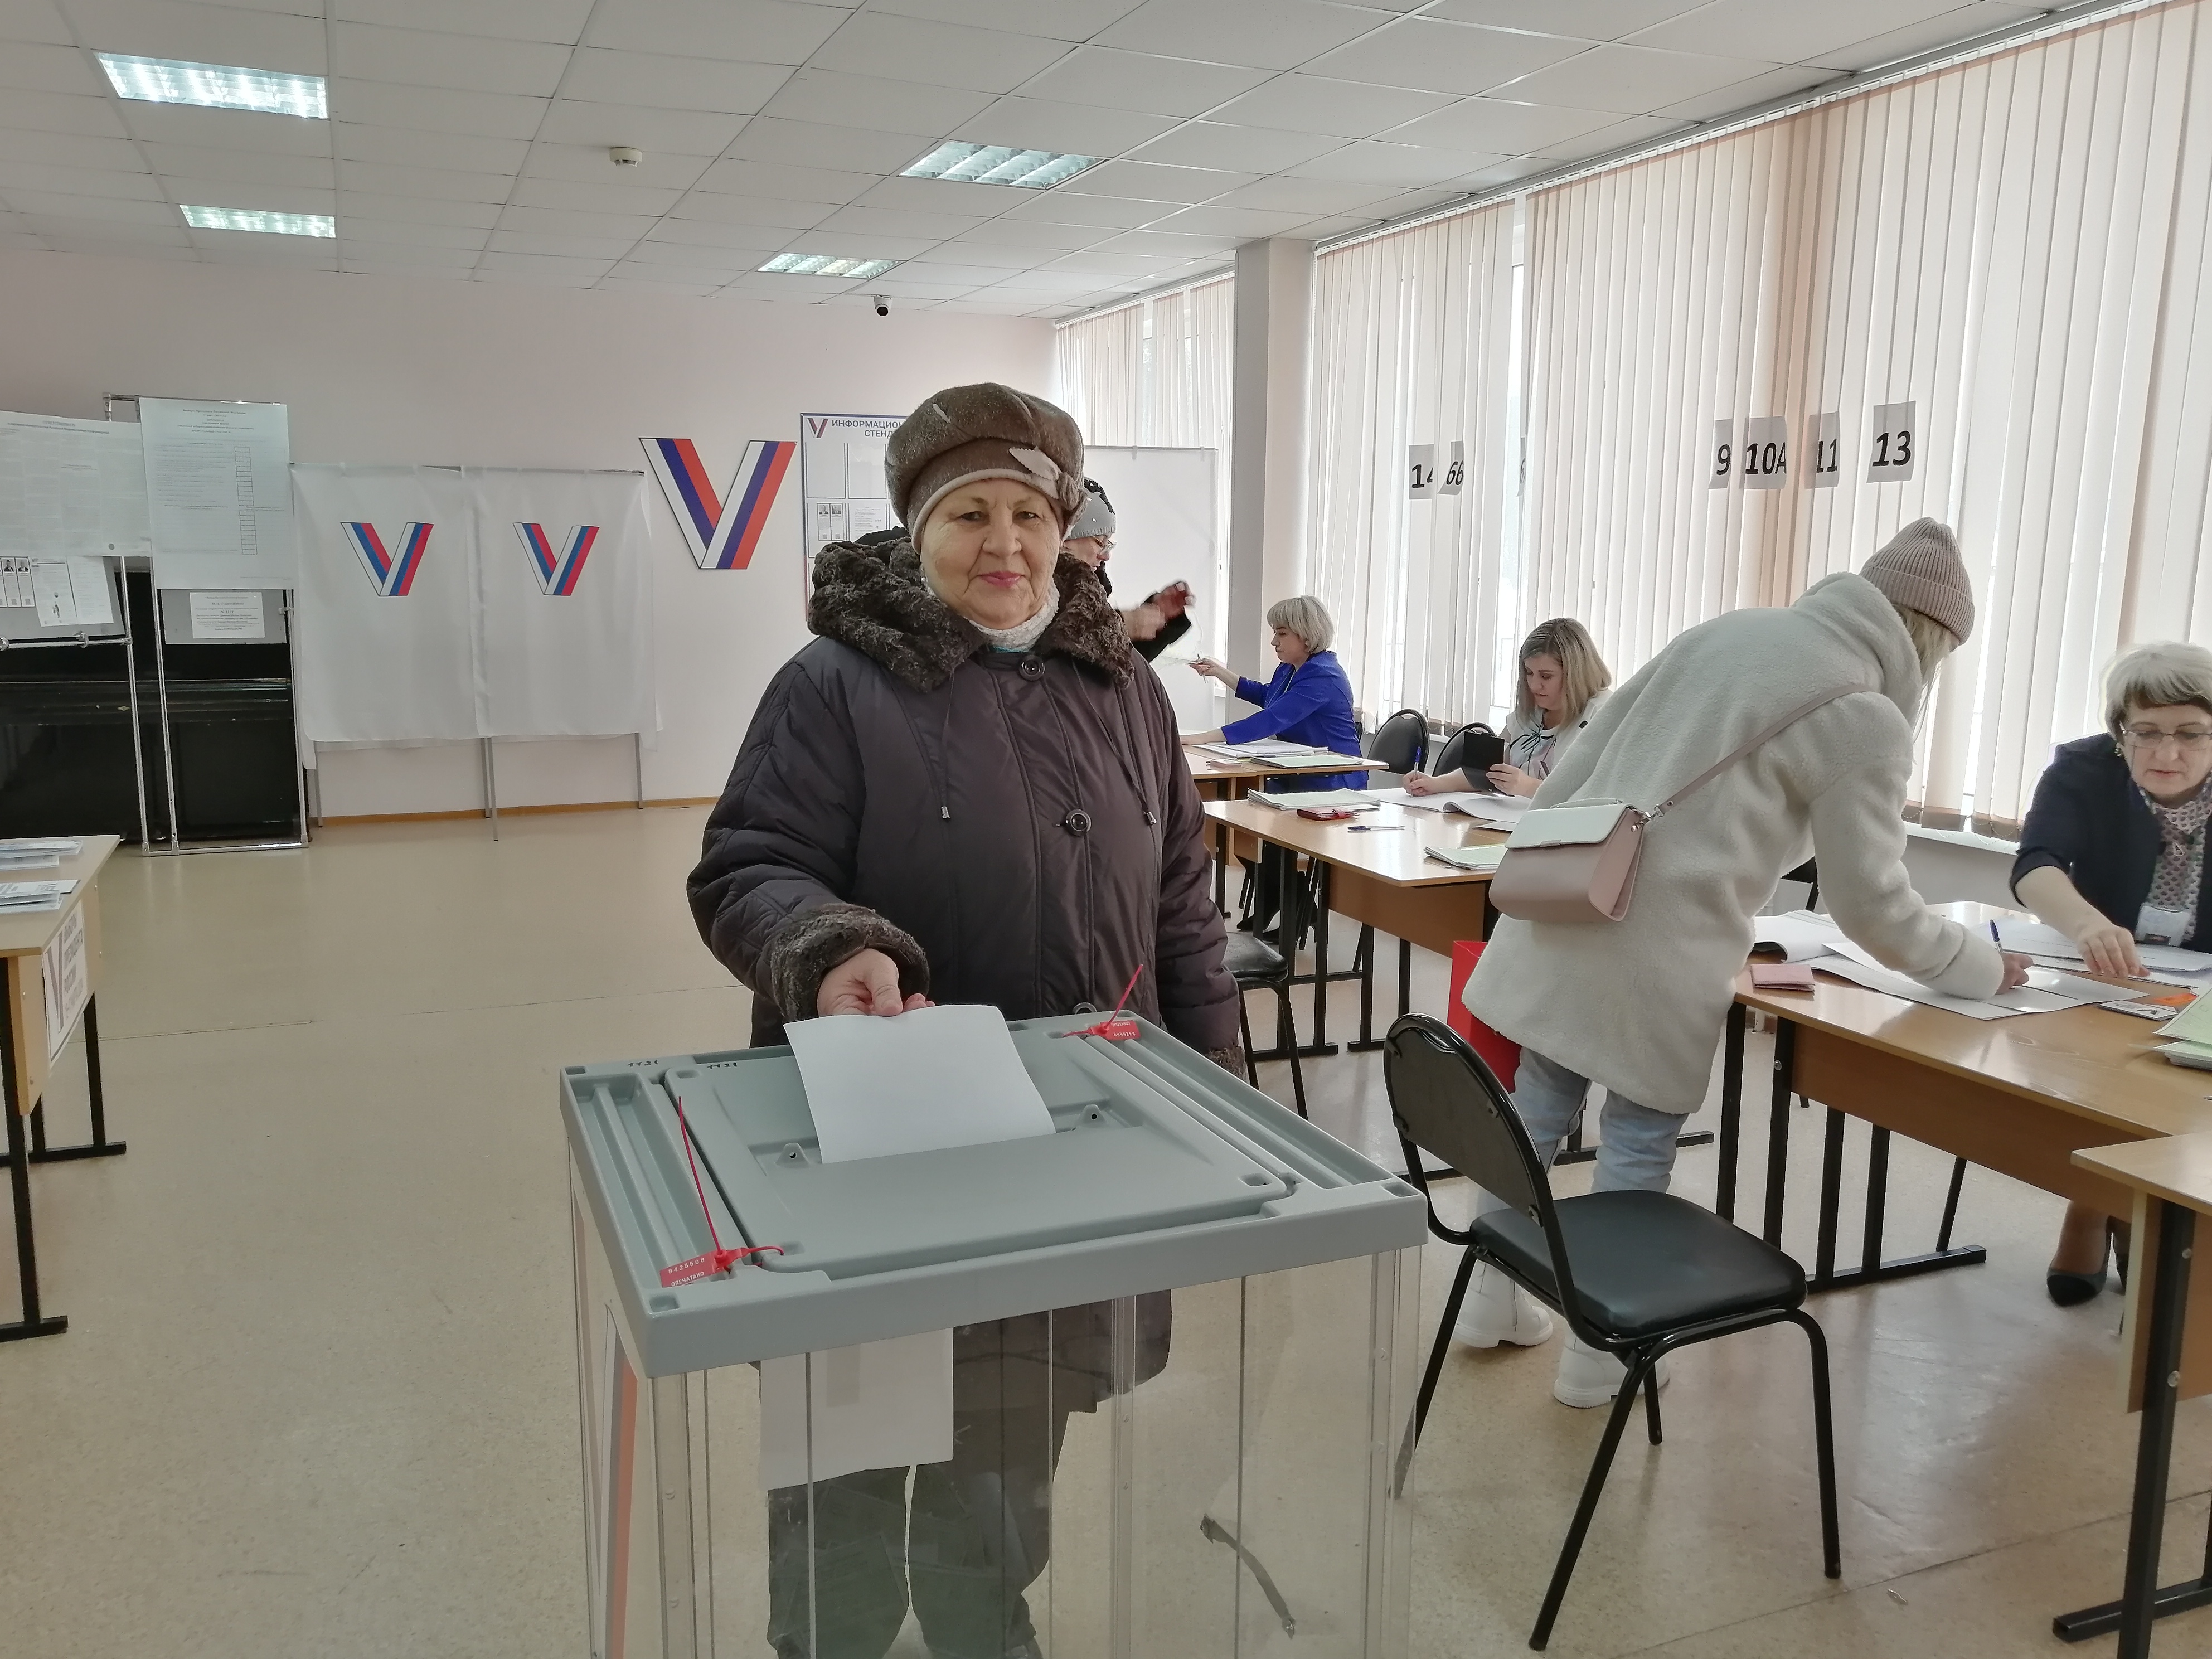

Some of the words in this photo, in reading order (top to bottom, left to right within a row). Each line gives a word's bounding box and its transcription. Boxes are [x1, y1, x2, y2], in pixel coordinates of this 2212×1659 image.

[1716, 444, 1731, 476] 9
[1872, 430, 1912, 467] 13
[671, 1271, 705, 1287] ОПЕЧАТАНО
